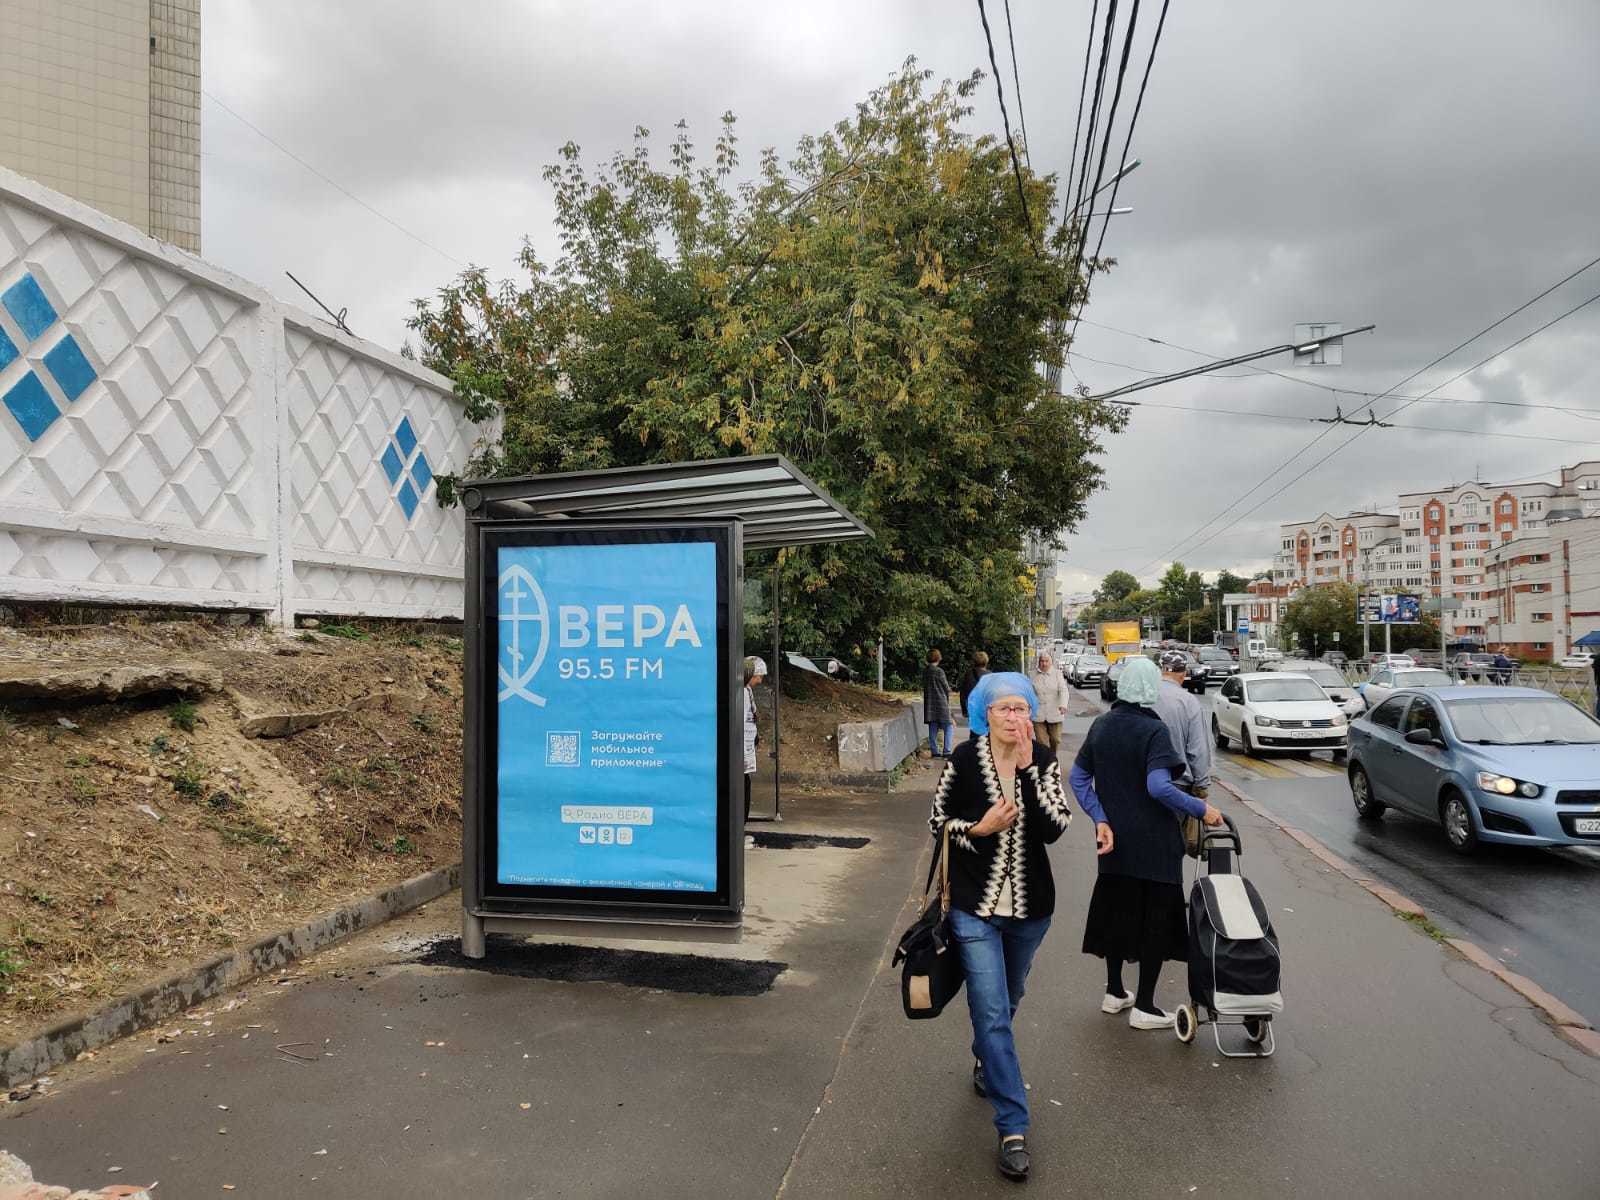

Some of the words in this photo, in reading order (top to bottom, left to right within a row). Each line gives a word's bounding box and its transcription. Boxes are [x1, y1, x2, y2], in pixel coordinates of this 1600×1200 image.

[559, 604, 702, 648] ВЕРА
[558, 657, 615, 680] 95.5
[625, 657, 663, 680] FM
[591, 729, 664, 743] Загружайте
[591, 744, 655, 754] мобильное
[576, 807, 613, 820] Радио
[617, 808, 648, 821] ВЕРА
